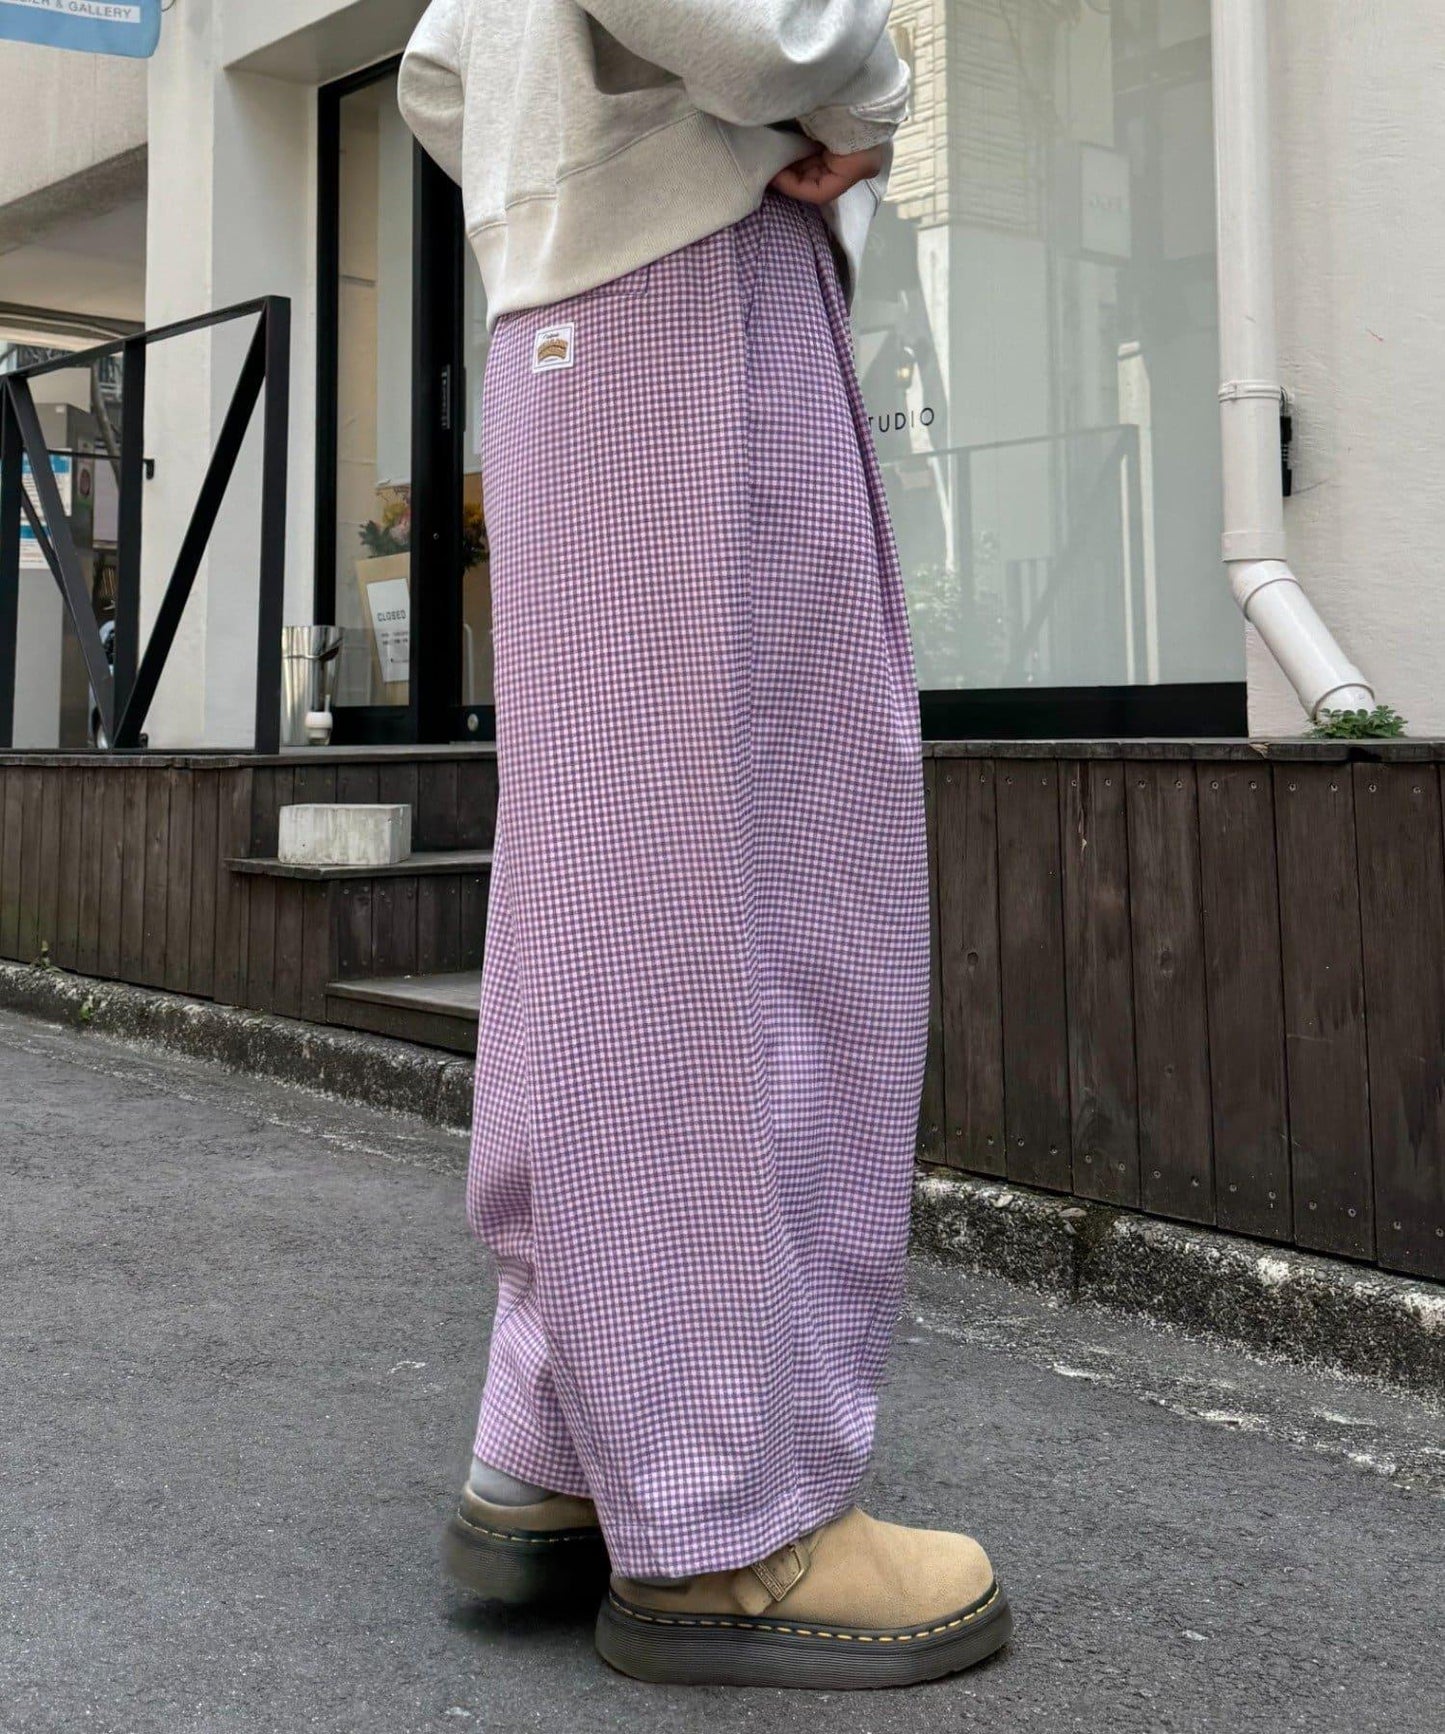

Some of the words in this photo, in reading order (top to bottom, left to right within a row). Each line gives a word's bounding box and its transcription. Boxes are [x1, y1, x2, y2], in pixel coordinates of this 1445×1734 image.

[68, 1, 132, 19] GALLERY
[868, 407, 934, 433] TUDIO
[377, 609, 407, 622] CLOSED
